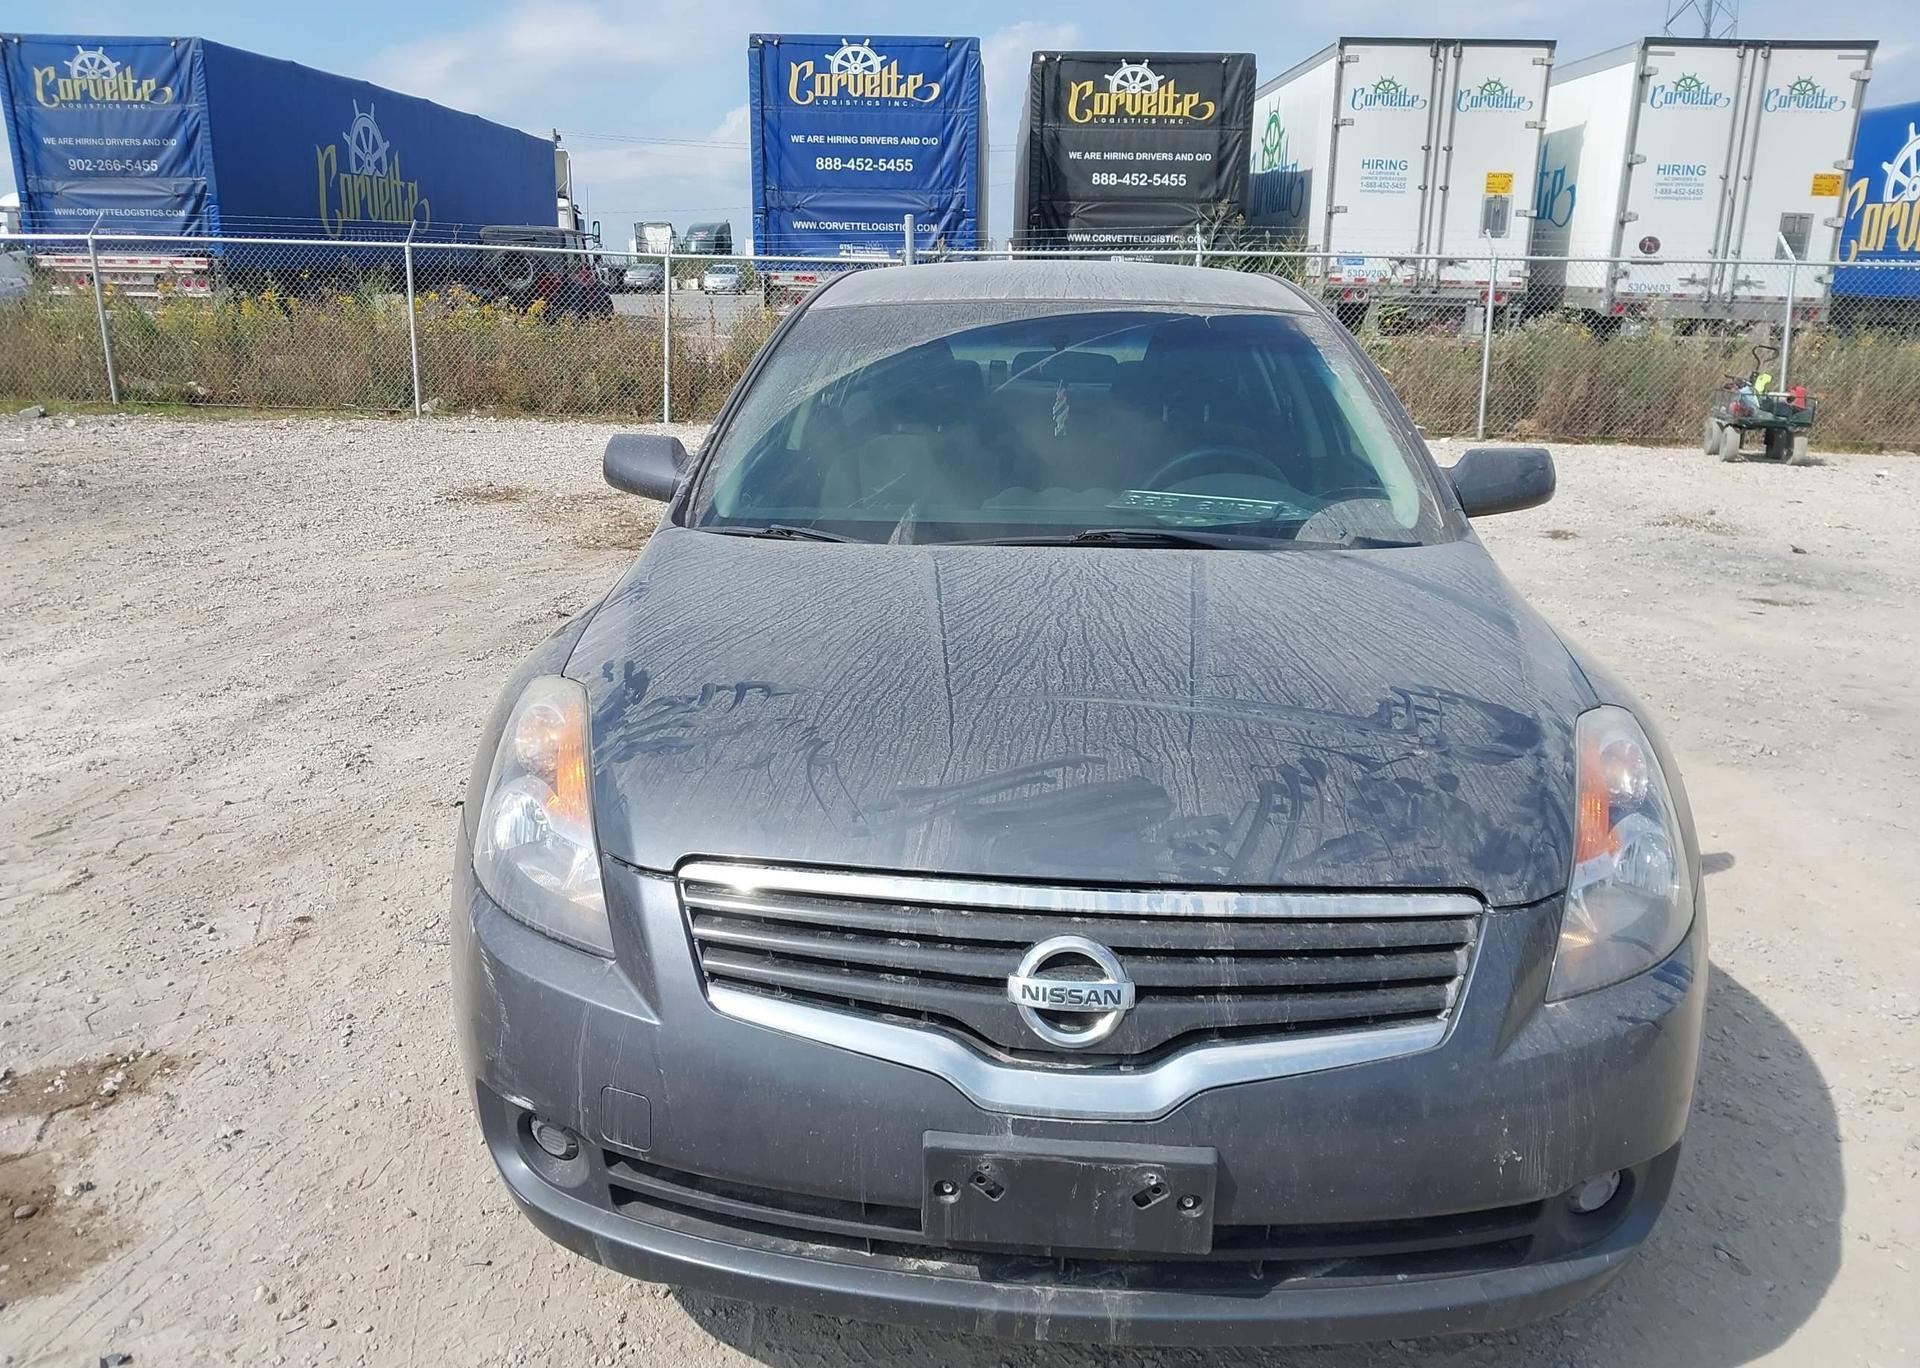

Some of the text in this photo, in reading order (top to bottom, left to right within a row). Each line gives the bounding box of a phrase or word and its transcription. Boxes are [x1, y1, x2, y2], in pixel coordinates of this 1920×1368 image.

[33, 65, 173, 108] Corvette
[788, 59, 941, 105] Corvette
[815, 99, 880, 107] LOGISTICS
[1068, 79, 1215, 123] Corvette
[1351, 87, 1427, 111] Corvette
[1457, 88, 1534, 112] Corvette
[1650, 84, 1731, 109] Corvette
[1765, 88, 1846, 113] Corvette
[43, 137, 57, 145] WE
[58, 137, 74, 145] ARE
[75, 138, 104, 146] HIRING
[106, 138, 141, 146] DRIVERS
[142, 138, 160, 146] AND
[790, 135, 938, 146] WE ARE HIRING DRIVERS AND O/O
[1068, 151, 1212, 162] WE ARE HIRING DRIVERS AND O/O
[68, 159, 158, 172] 902-266-5455
[815, 157, 914, 172] 888-452-5455
[1361, 159, 1409, 171] HIRING
[1656, 164, 1707, 176] HIRING
[1091, 172, 1187, 187] 888-452-5455
[315, 144, 430, 238] Corvette
[792, 221, 938, 232] WWW.CORVETTELOGISTI.COM
[1067, 234, 1208, 243] WWW.CORVETTELOGISTICS.CO
[1021, 984, 1122, 1005] NISSAN
